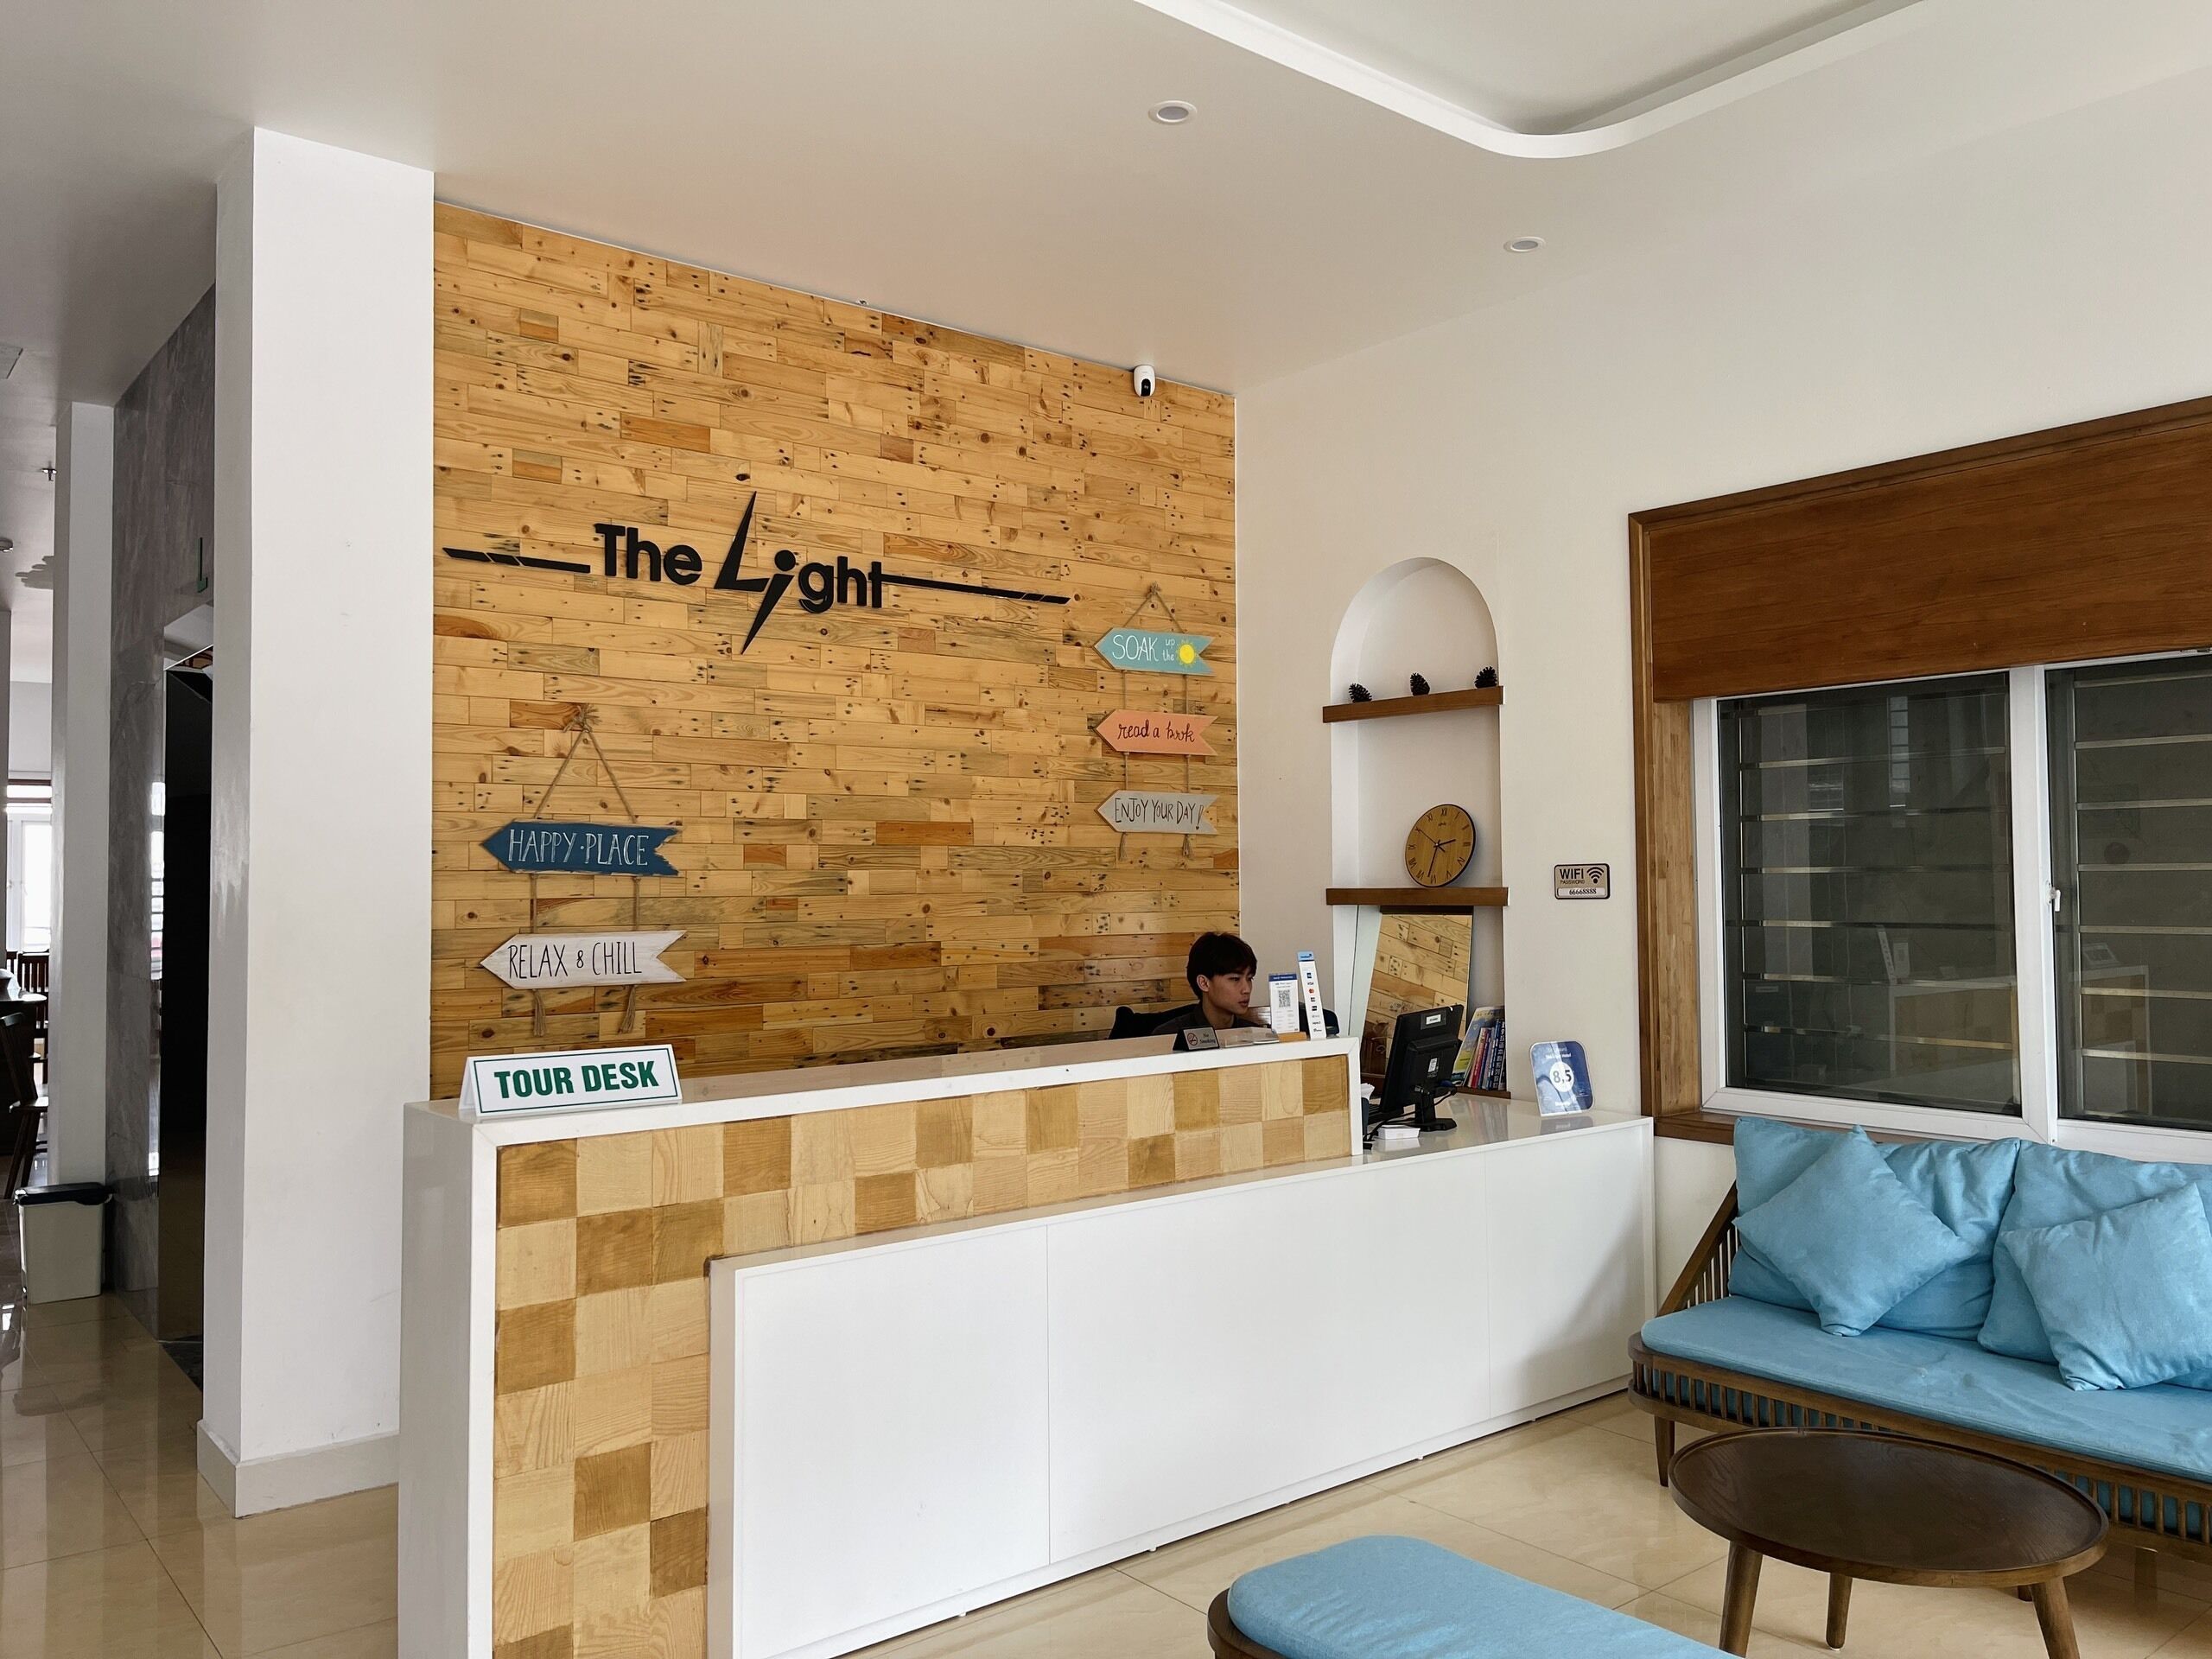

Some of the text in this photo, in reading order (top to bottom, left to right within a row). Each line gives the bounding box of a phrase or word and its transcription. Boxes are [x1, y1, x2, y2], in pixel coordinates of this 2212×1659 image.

[594, 491, 883, 655] The Light
[1112, 634, 1176, 662] SOAK up the
[1117, 719, 1196, 743] read a book
[1115, 798, 1149, 823] ENJOY
[1151, 798, 1174, 823] YOUR
[508, 829, 650, 866] HAPPY PLACE
[1559, 868, 1584, 880] WIFI
[507, 944, 569, 980] RELAX
[592, 941, 642, 976] CHILL
[494, 1060, 659, 1099] TOUR DESK
[1553, 1069, 1573, 1084] 8,5
